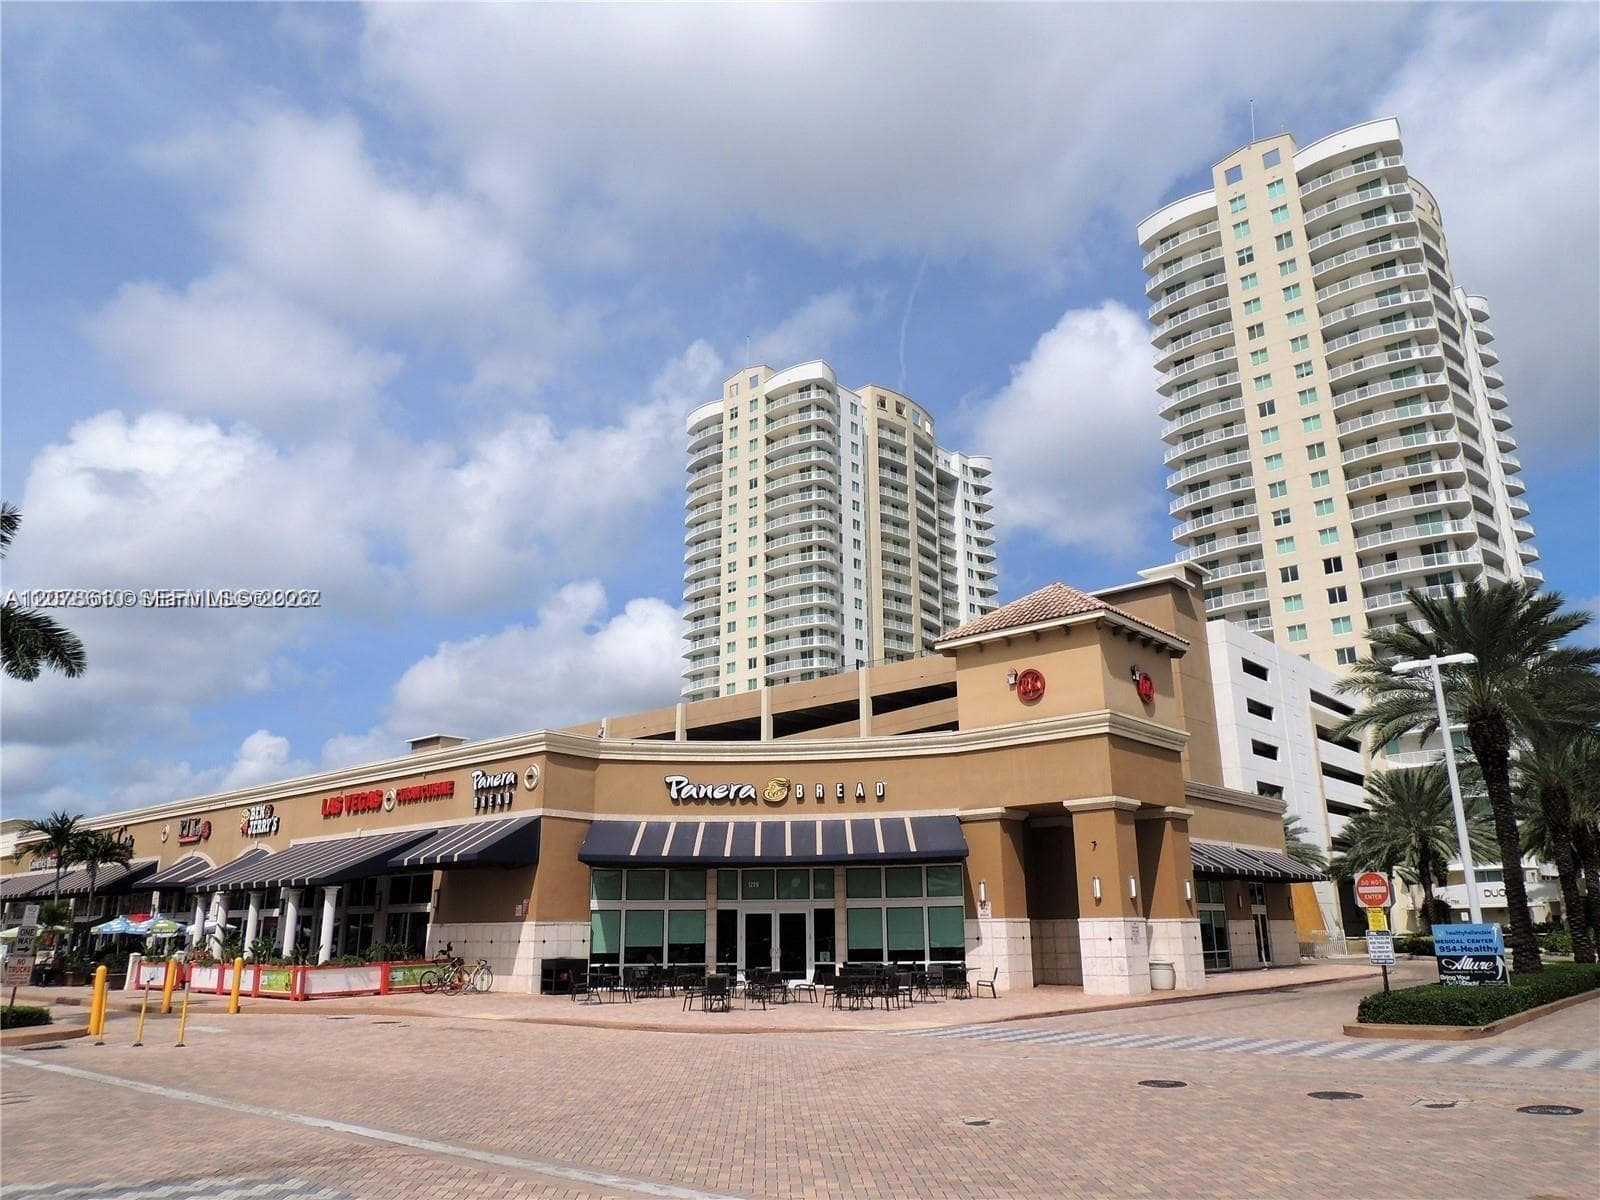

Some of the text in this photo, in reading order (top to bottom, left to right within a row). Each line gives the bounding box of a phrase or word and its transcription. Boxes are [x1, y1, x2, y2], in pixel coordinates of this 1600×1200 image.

[471, 769, 517, 791] Panera
[665, 775, 885, 800] Panera BREAD
[321, 796, 343, 816] LAS
[344, 790, 384, 812] VEGAS
[421, 780, 455, 798] CUISINE
[473, 792, 512, 809] BREAD
[250, 806, 265, 820] BEN
[248, 817, 279, 834] JERRY'S
[20, 928, 35, 937] ONE
[1439, 945, 1498, 953] 954-Healthy
[1442, 955, 1494, 970] Allure
